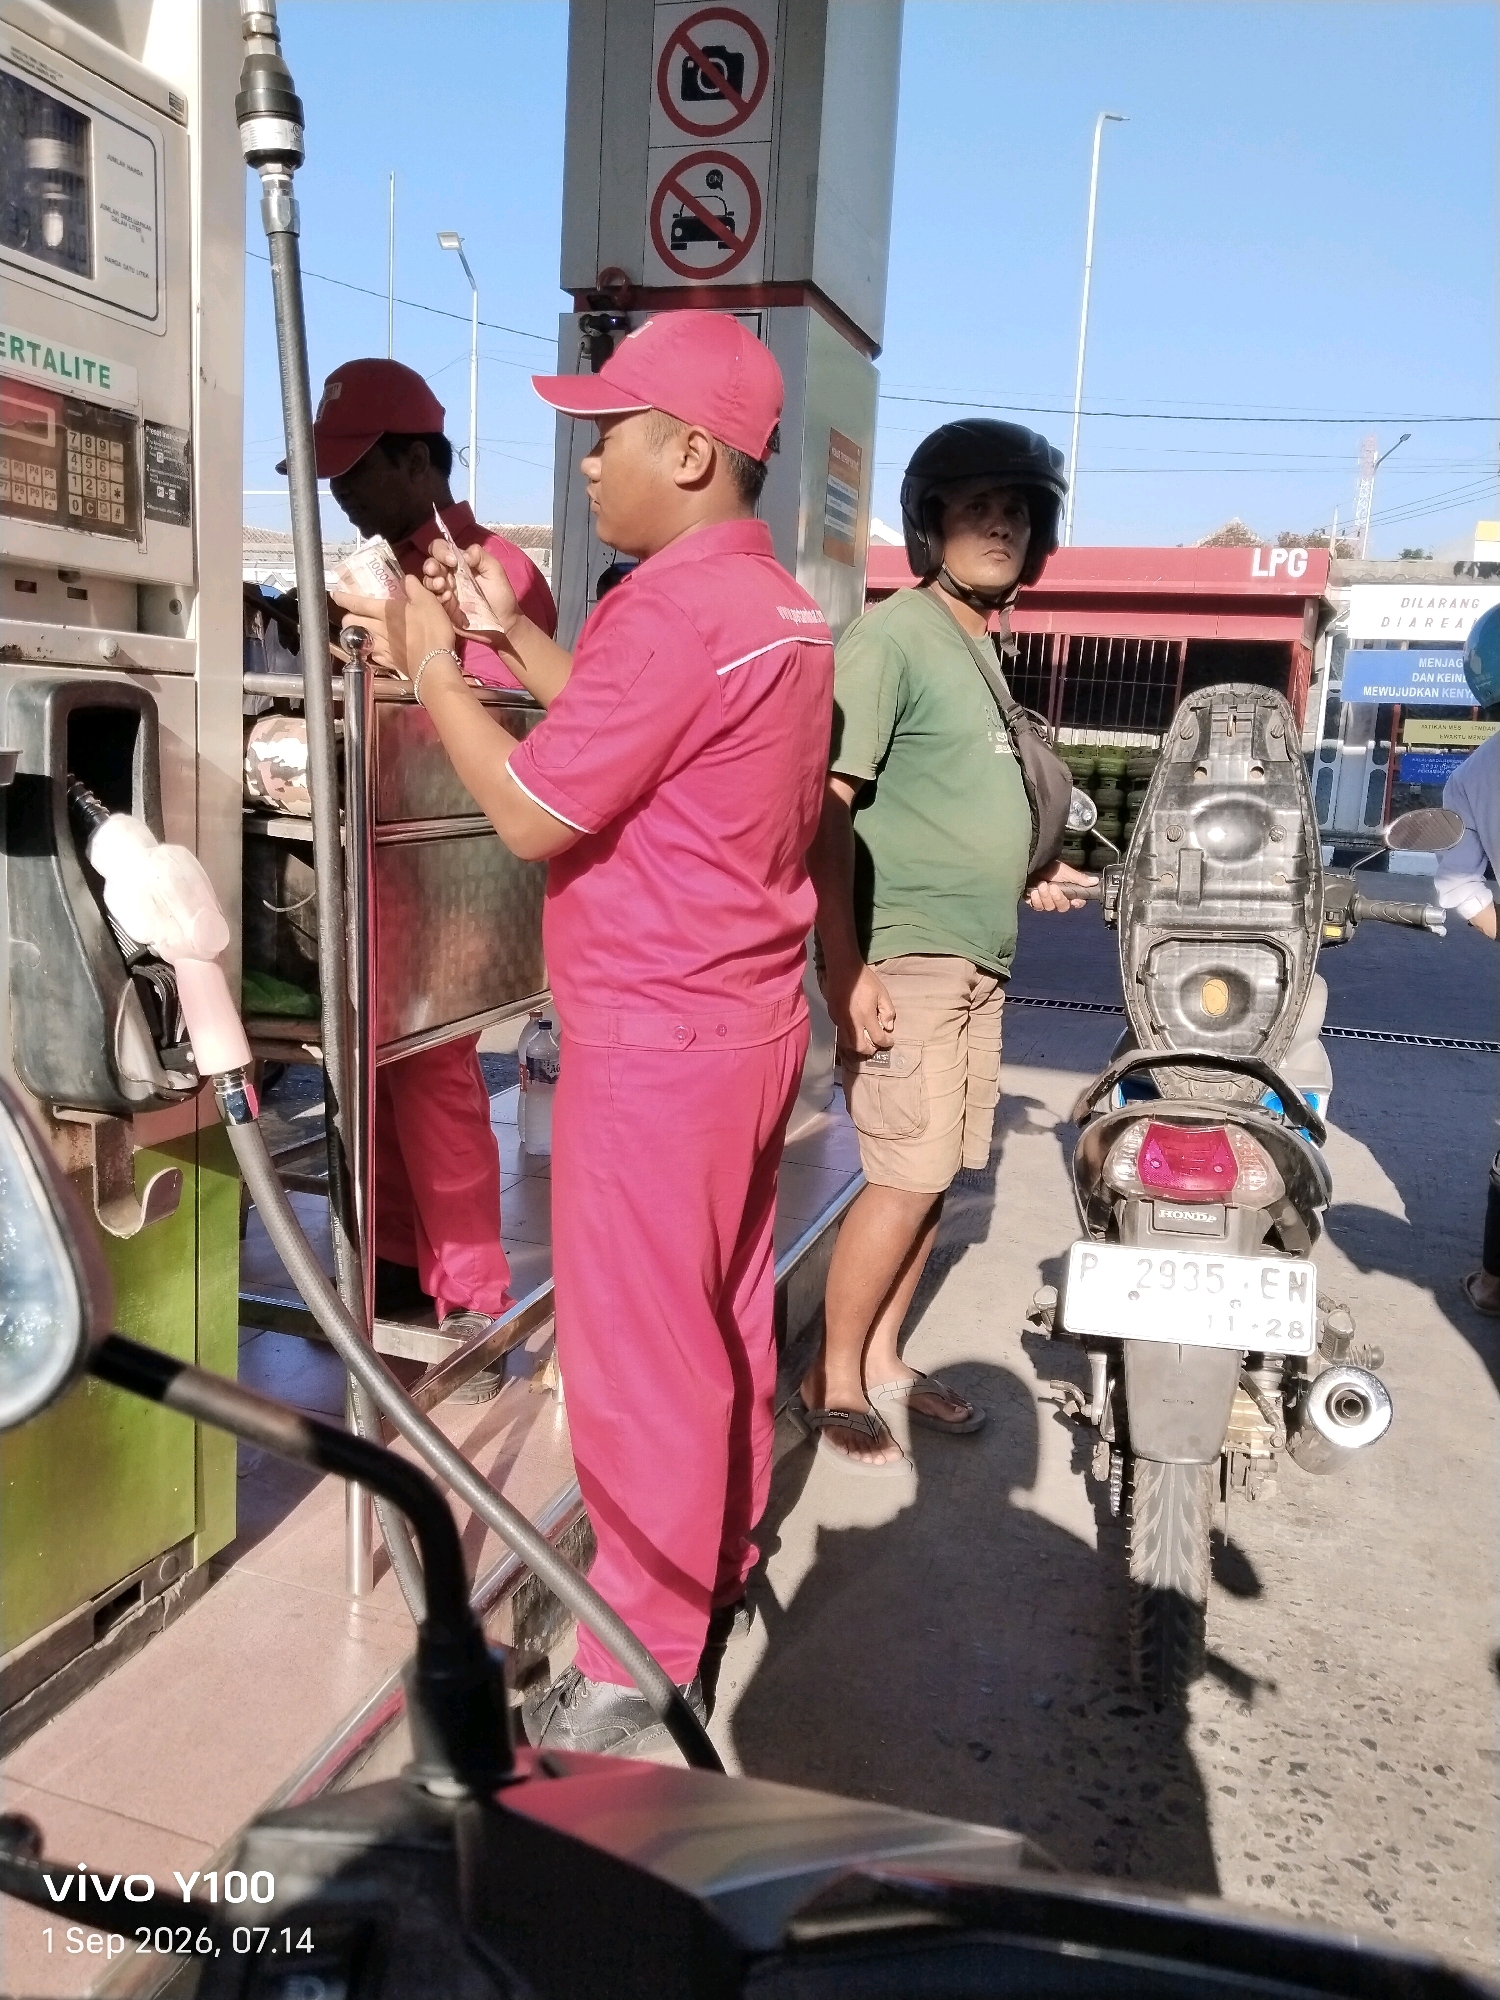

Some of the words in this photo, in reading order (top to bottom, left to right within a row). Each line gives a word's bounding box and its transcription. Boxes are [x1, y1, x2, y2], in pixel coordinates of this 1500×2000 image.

[69, 431, 78, 444] 7
[85, 436, 92, 449] 8
[99, 440, 107, 452] 9
[71, 453, 78, 466] 4
[85, 457, 93, 469] 5
[99, 460, 107, 473] 6
[29, 465, 40, 476] P4
[45, 469, 54, 480] P5
[85, 478, 94, 491] 2
[99, 481, 107, 494] 3
[72, 499, 80, 512] 0
[1252, 548, 1309, 578] LPG
[1400, 597, 1480, 609] DILARANG
[1411, 672, 1434, 683] DAN
[1363, 686, 1439, 698] MEWUJUDKAN
[1158, 1209, 1218, 1223] HONDA
[1079, 1252, 1099, 1283] P
[1136, 1257, 1225, 1294] 2935
